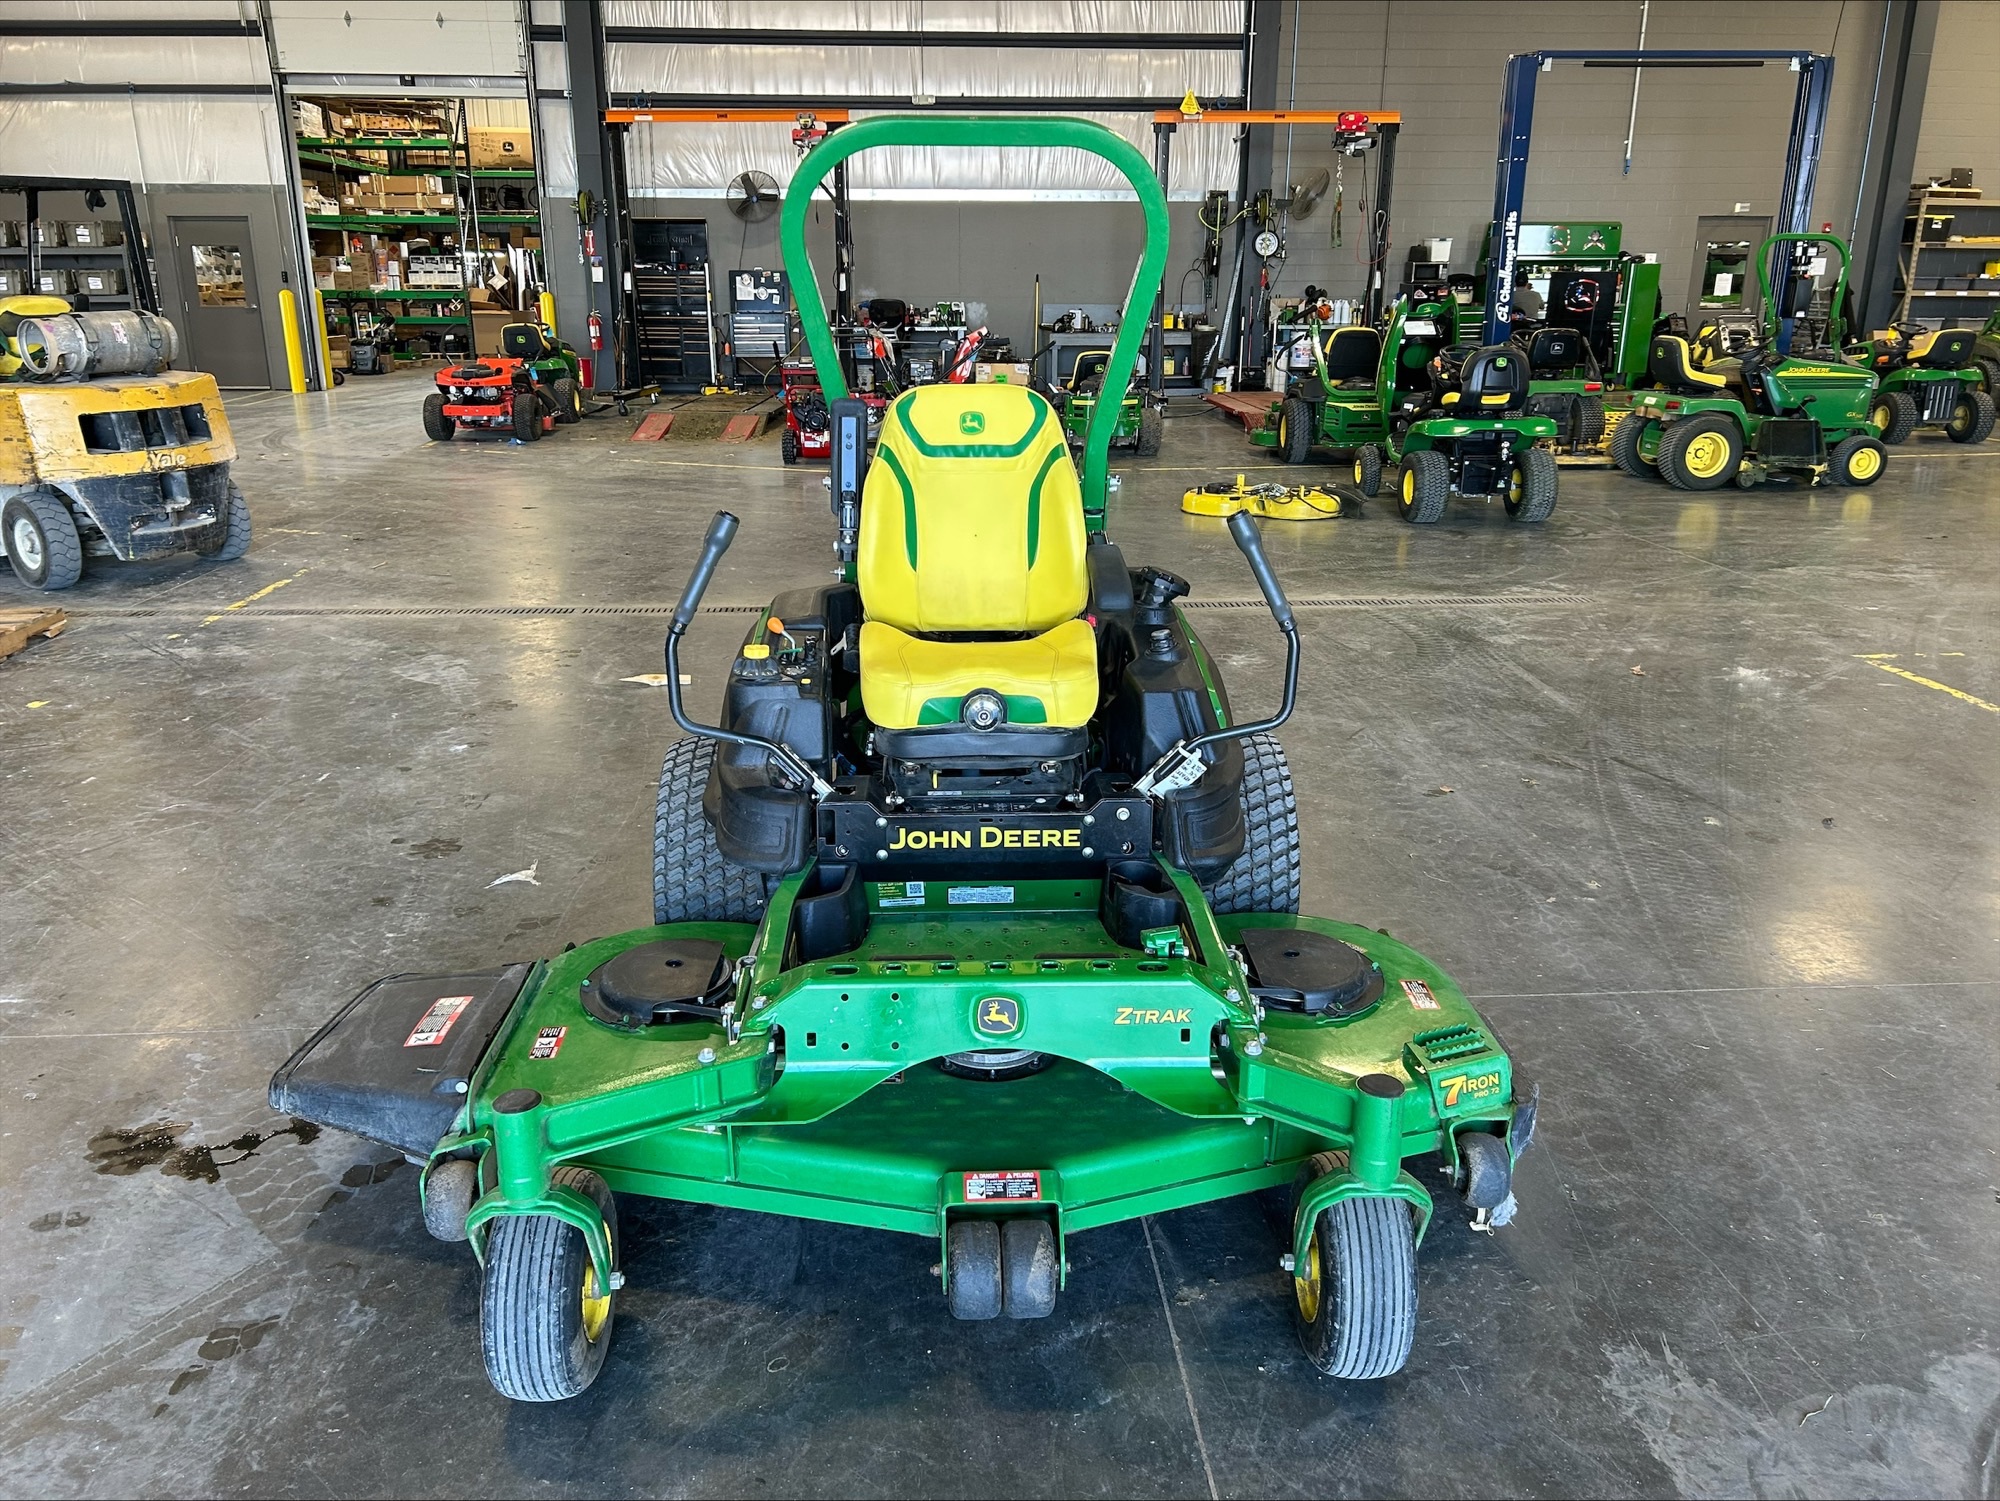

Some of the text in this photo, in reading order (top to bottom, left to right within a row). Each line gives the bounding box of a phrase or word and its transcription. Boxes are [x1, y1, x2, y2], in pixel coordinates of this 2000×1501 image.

[1505, 211, 1517, 236] Lifts
[1499, 237, 1515, 303] Challenger
[150, 450, 187, 470] Yale
[889, 826, 1081, 849] JOHN DEERE
[1113, 1006, 1194, 1025] ZTRAK
[1474, 1086, 1500, 1099] PRO 72
